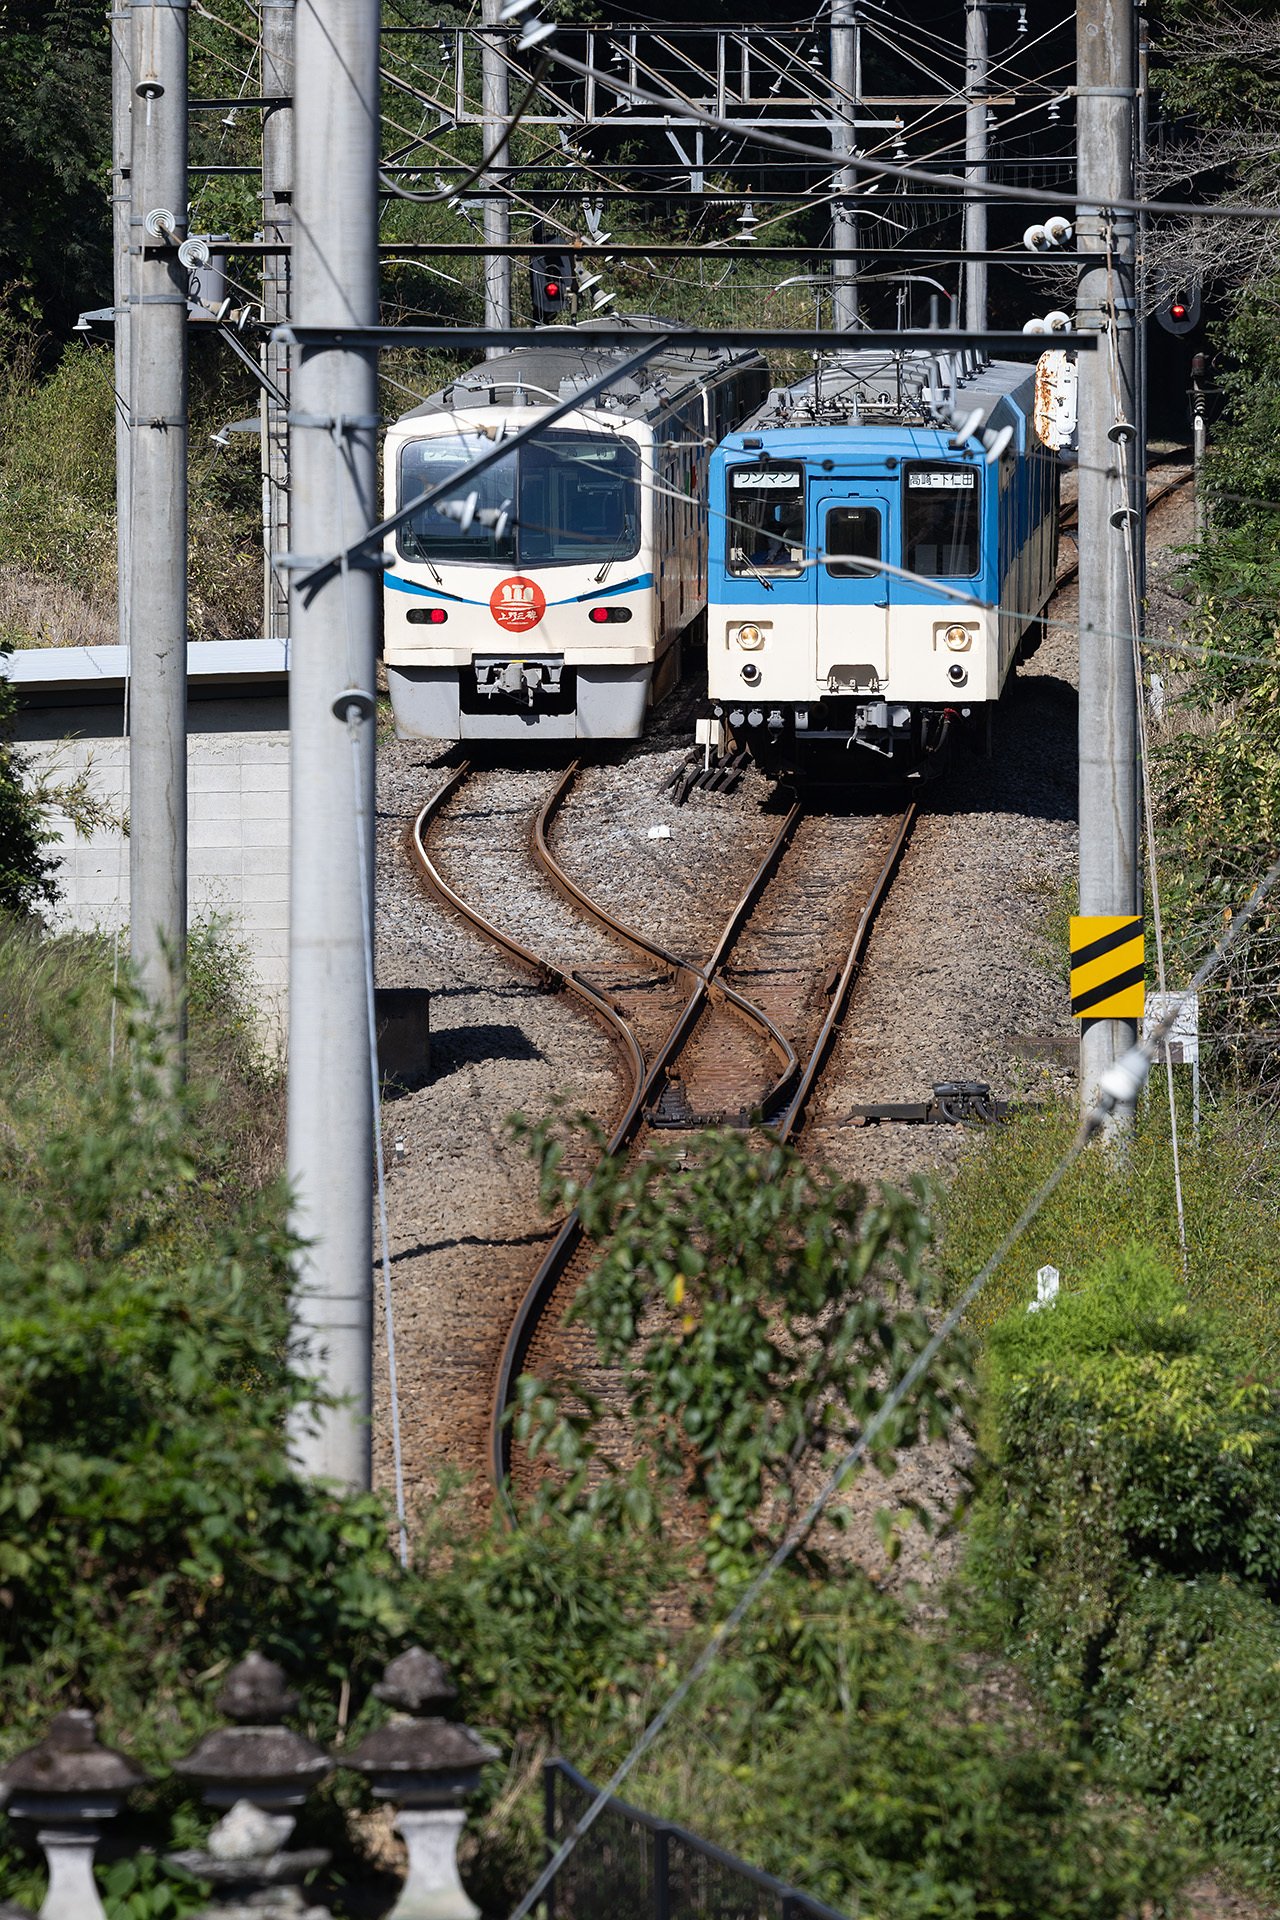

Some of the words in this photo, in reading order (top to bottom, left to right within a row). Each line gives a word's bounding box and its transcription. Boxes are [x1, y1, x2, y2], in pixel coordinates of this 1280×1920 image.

[737, 472, 794, 484] ワンマン
[497, 610, 538, 622] 上野三碑
